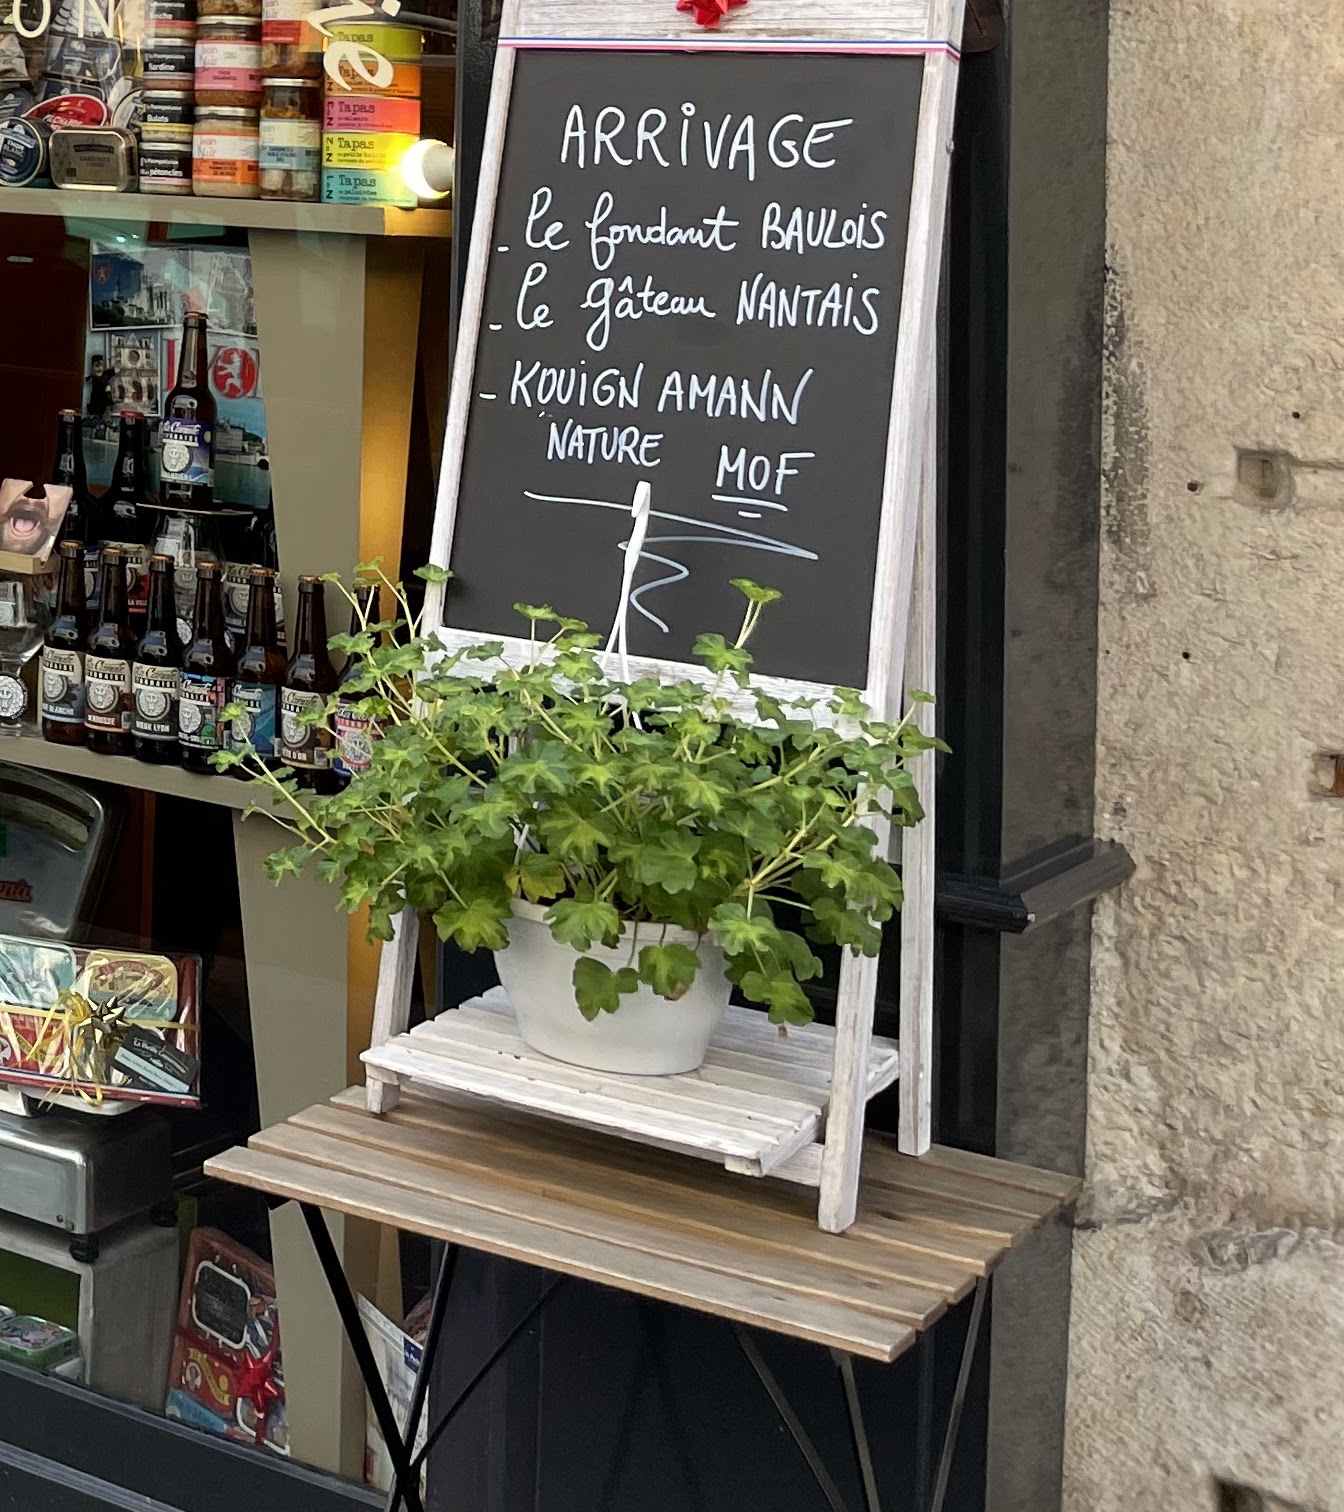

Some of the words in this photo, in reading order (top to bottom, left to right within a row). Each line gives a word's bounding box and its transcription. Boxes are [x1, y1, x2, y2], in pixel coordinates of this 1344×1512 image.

[338, 101, 375, 115] Tapas
[338, 137, 374, 151] Tapas
[338, 174, 376, 189] Tapas
[584, 190, 740, 271] fondant
[580, 274, 716, 352] gâteau
[657, 368, 814, 426] AMANN
[546, 418, 665, 469] NATURE
[716, 447, 816, 496] MOF
